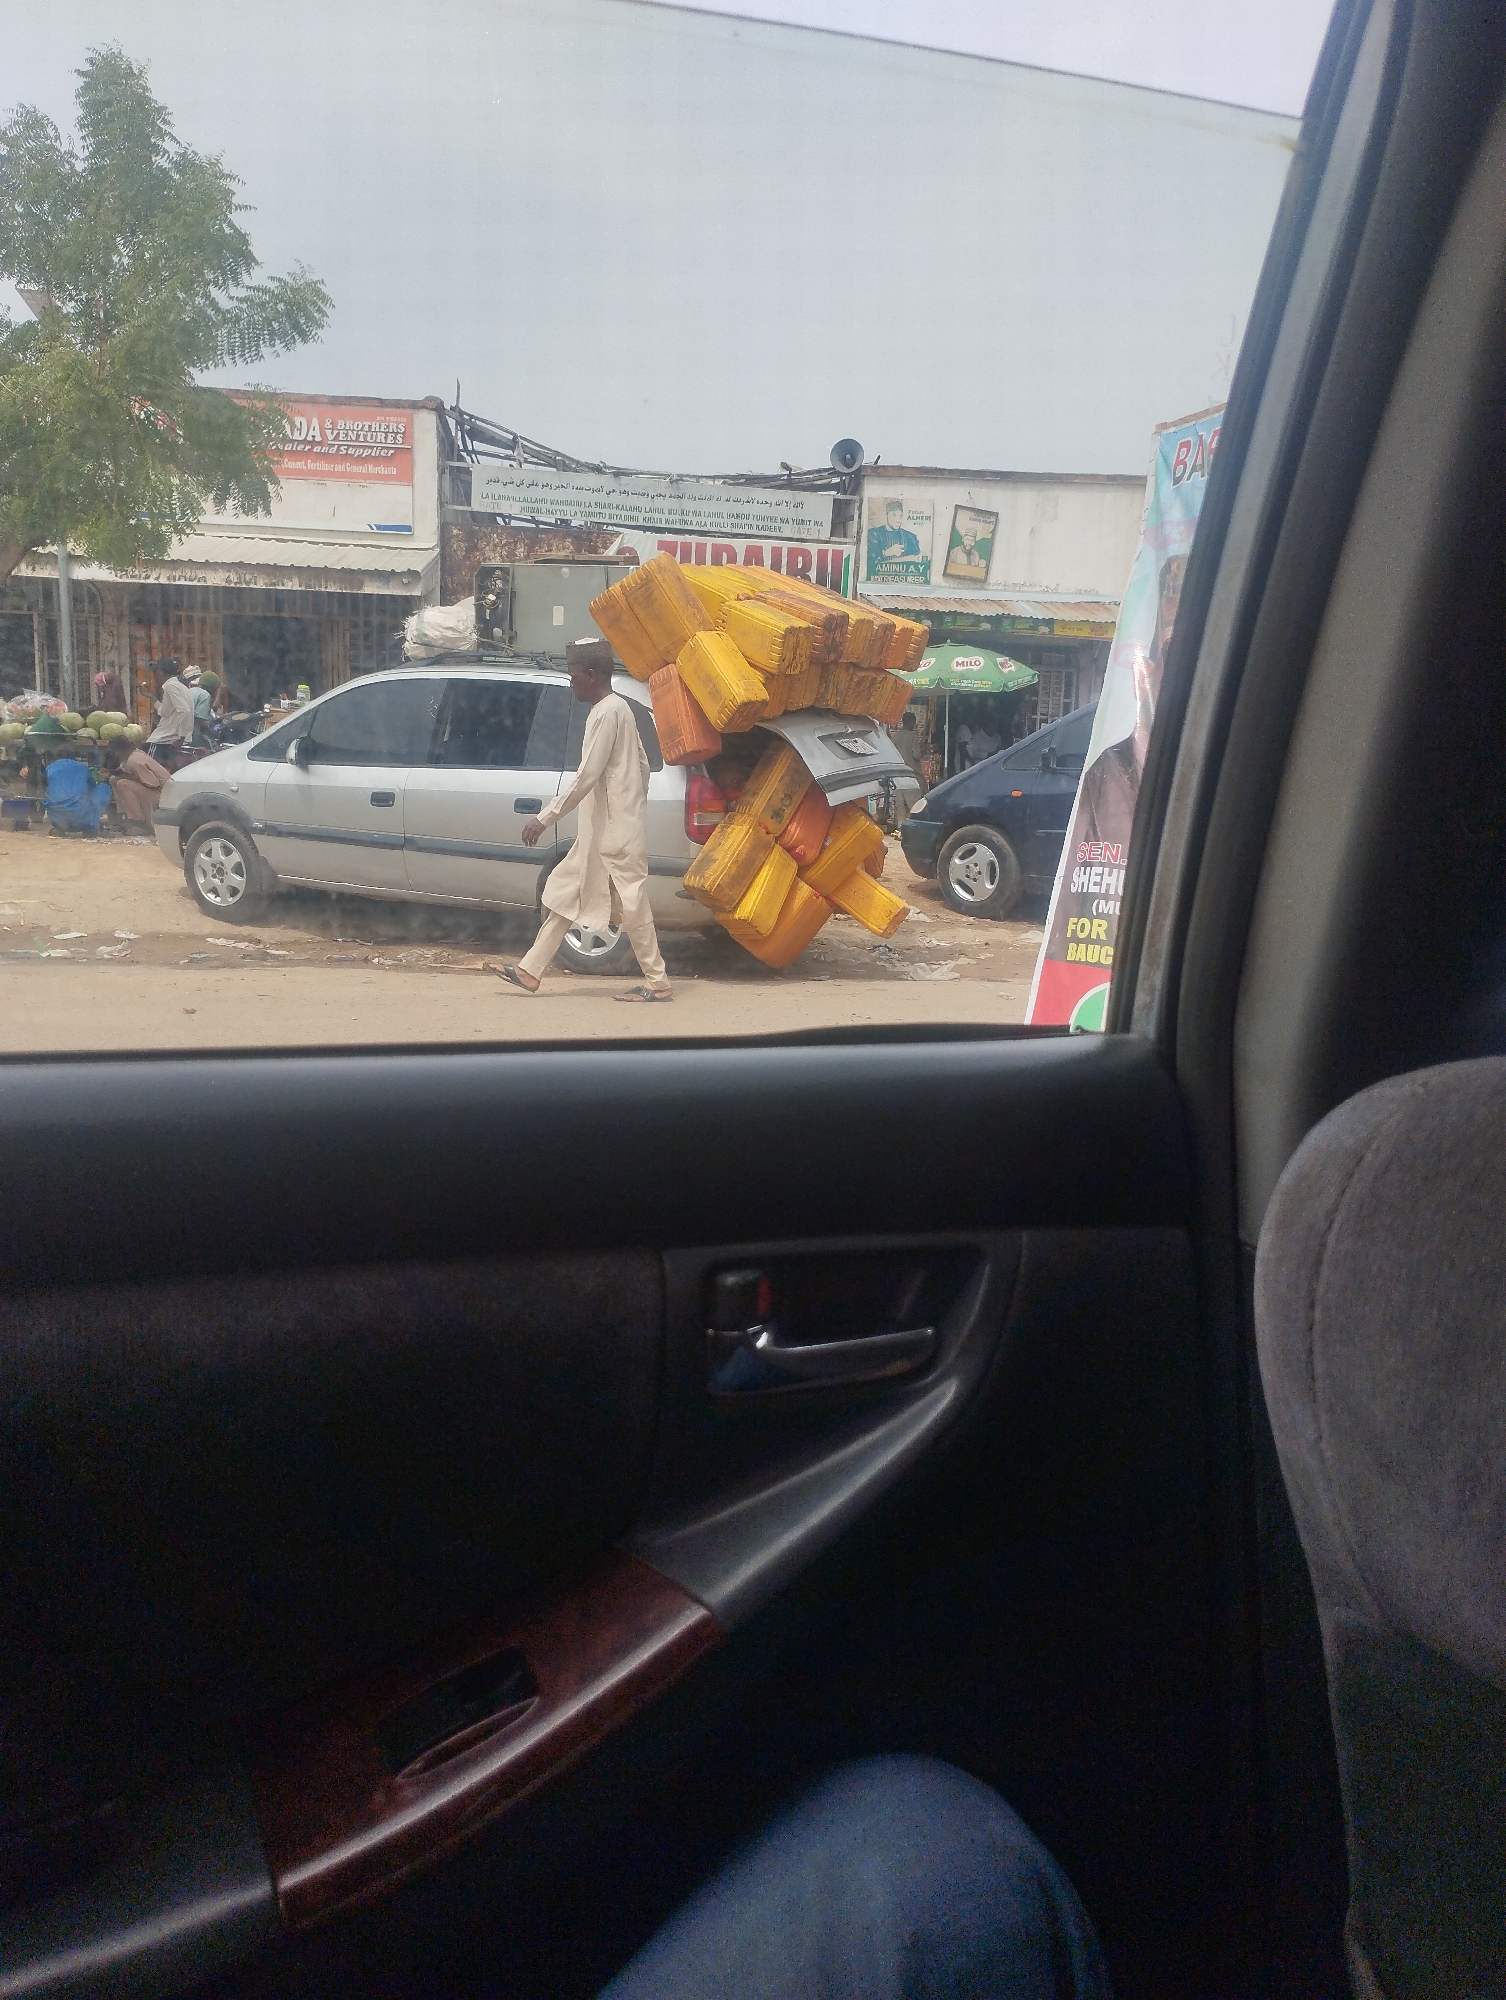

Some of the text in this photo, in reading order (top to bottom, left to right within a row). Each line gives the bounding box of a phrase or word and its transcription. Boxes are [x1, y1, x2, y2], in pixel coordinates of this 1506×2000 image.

[324, 418, 333, 429] &
[337, 420, 405, 433] BROTHERS
[325, 430, 403, 444] VENTURES
[313, 444, 338, 455] and
[339, 445, 396, 458] Supplier
[335, 463, 345, 472] and
[346, 463, 367, 474] General
[368, 464, 397, 475] Merchants
[875, 563, 906, 573] AMINU
[955, 659, 982, 668] MILO
[1077, 842, 1127, 866] SEN.
[1067, 917, 1108, 940] FOR
[1067, 942, 1114, 965] BAUC
